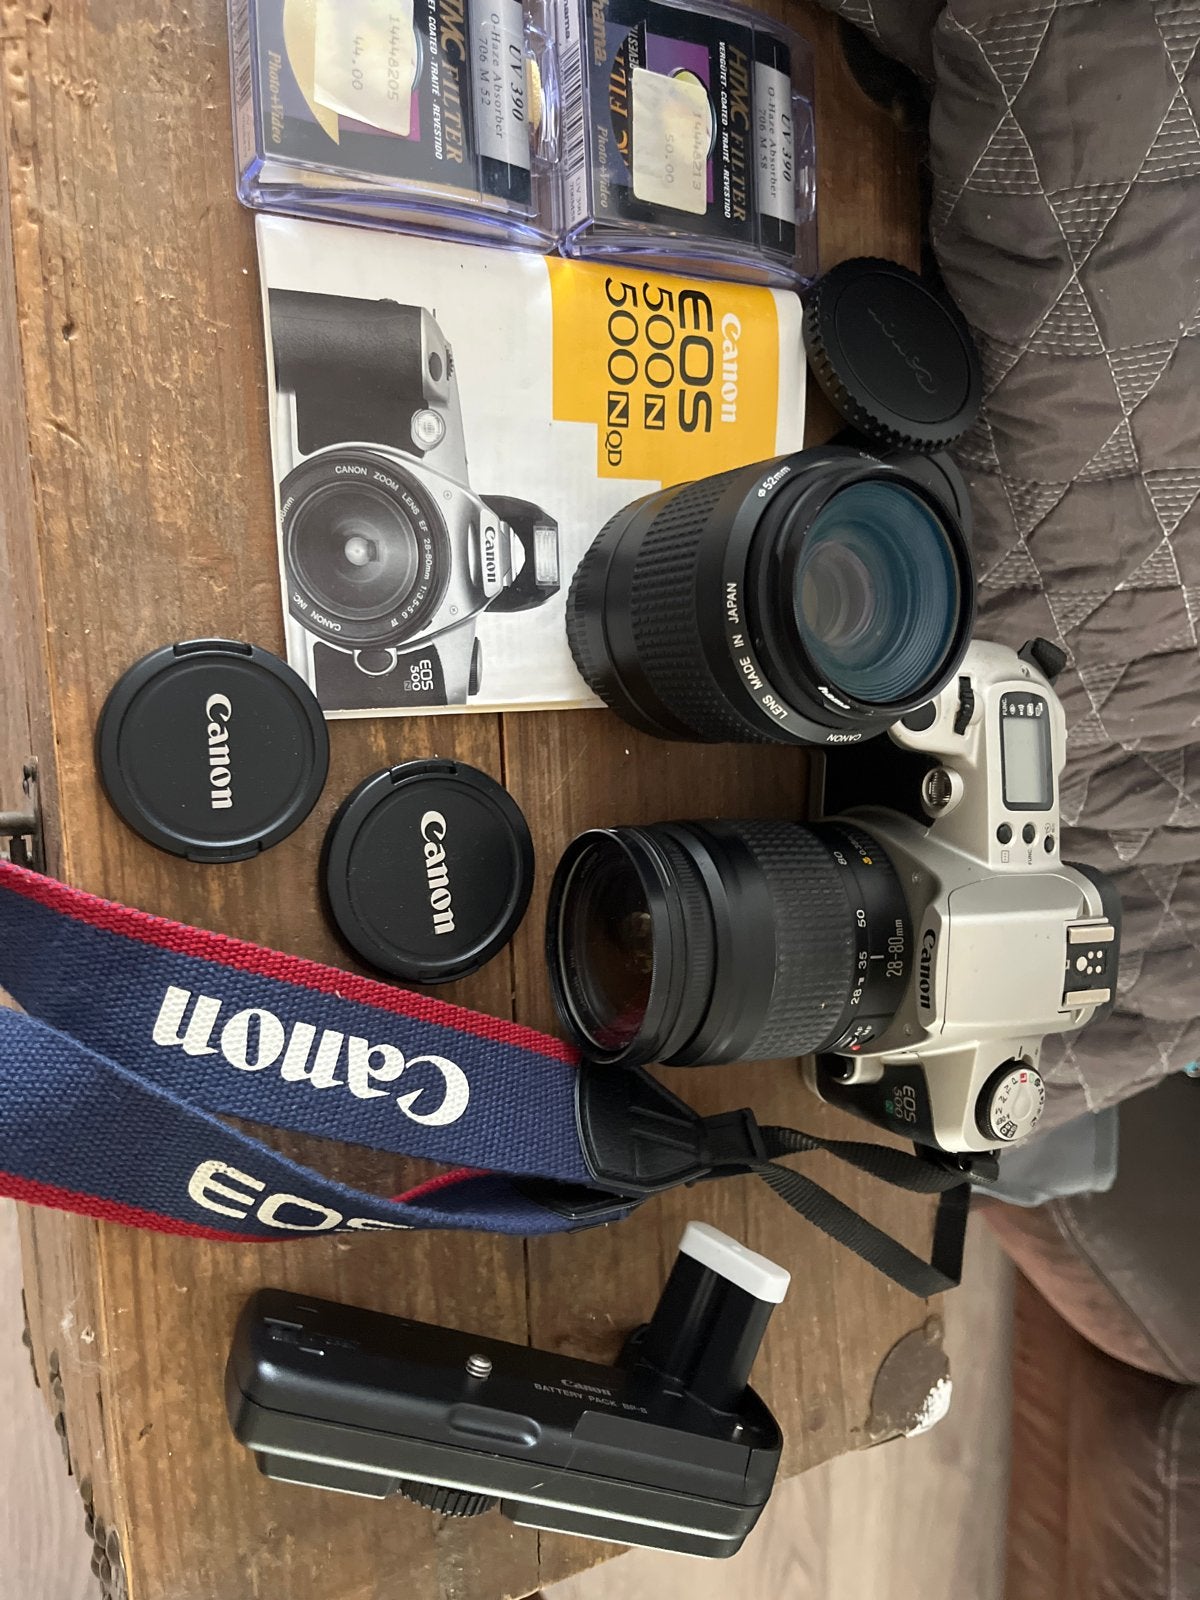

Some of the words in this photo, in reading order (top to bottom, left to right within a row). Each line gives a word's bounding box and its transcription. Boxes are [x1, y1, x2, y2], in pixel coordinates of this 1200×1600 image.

[429, 16, 437, 54] COATED
[479, 38, 488, 62] 706
[352, 37, 363, 90] 44.00
[388, 15, 400, 102] 14448205
[509, 45, 521, 77] UV
[431, 62, 440, 96] TRAITÉ
[480, 69, 489, 82] M
[729, 45, 750, 130] HTMC
[442, 60, 462, 163] FILTER
[481, 90, 490, 105] 52
[493, 72, 504, 138] Absorber
[511, 82, 524, 121] 390
[433, 104, 442, 160] REVESTIDO
[759, 109, 767, 131] 706
[781, 114, 791, 143] UV
[722, 132, 730, 162] TRAITÉ
[760, 136, 767, 149] M
[731, 131, 746, 221] FILTER
[769, 141, 778, 198] Absorber
[782, 148, 792, 181] 390
[678, 290, 714, 432] EOS
[721, 313, 741, 422] Canon
[335, 466, 367, 475] CANON
[374, 472, 398, 491] ZOOM
[402, 493, 419, 515] LENS
[419, 520, 428, 532] EF
[484, 526, 498, 582] Canon
[726, 583, 740, 624] JAPAN
[310, 611, 341, 631] CANON
[732, 635, 744, 648] IN
[410, 666, 420, 690] 500
[420, 660, 433, 690] EOS
[740, 657, 763, 690] MADE
[762, 694, 788, 719] LENS
[206, 694, 233, 808] Canon
[826, 733, 862, 743] CANON
[420, 811, 456, 934] Canon
[834, 851, 847, 865] 80
[856, 909, 866, 928] 50
[858, 952, 868, 969] 35
[886, 919, 905, 977] 28-80mm
[919, 929, 936, 1009] Canon
[851, 988, 864, 1004] 28
[152, 986, 470, 1126] Canon
[893, 1086, 902, 1118] 500
[903, 1086, 916, 1122] EOS
[534, 1383, 582, 1398] BATTERY
[588, 1396, 617, 1407] PACK
[561, 1380, 611, 1396] Canon
